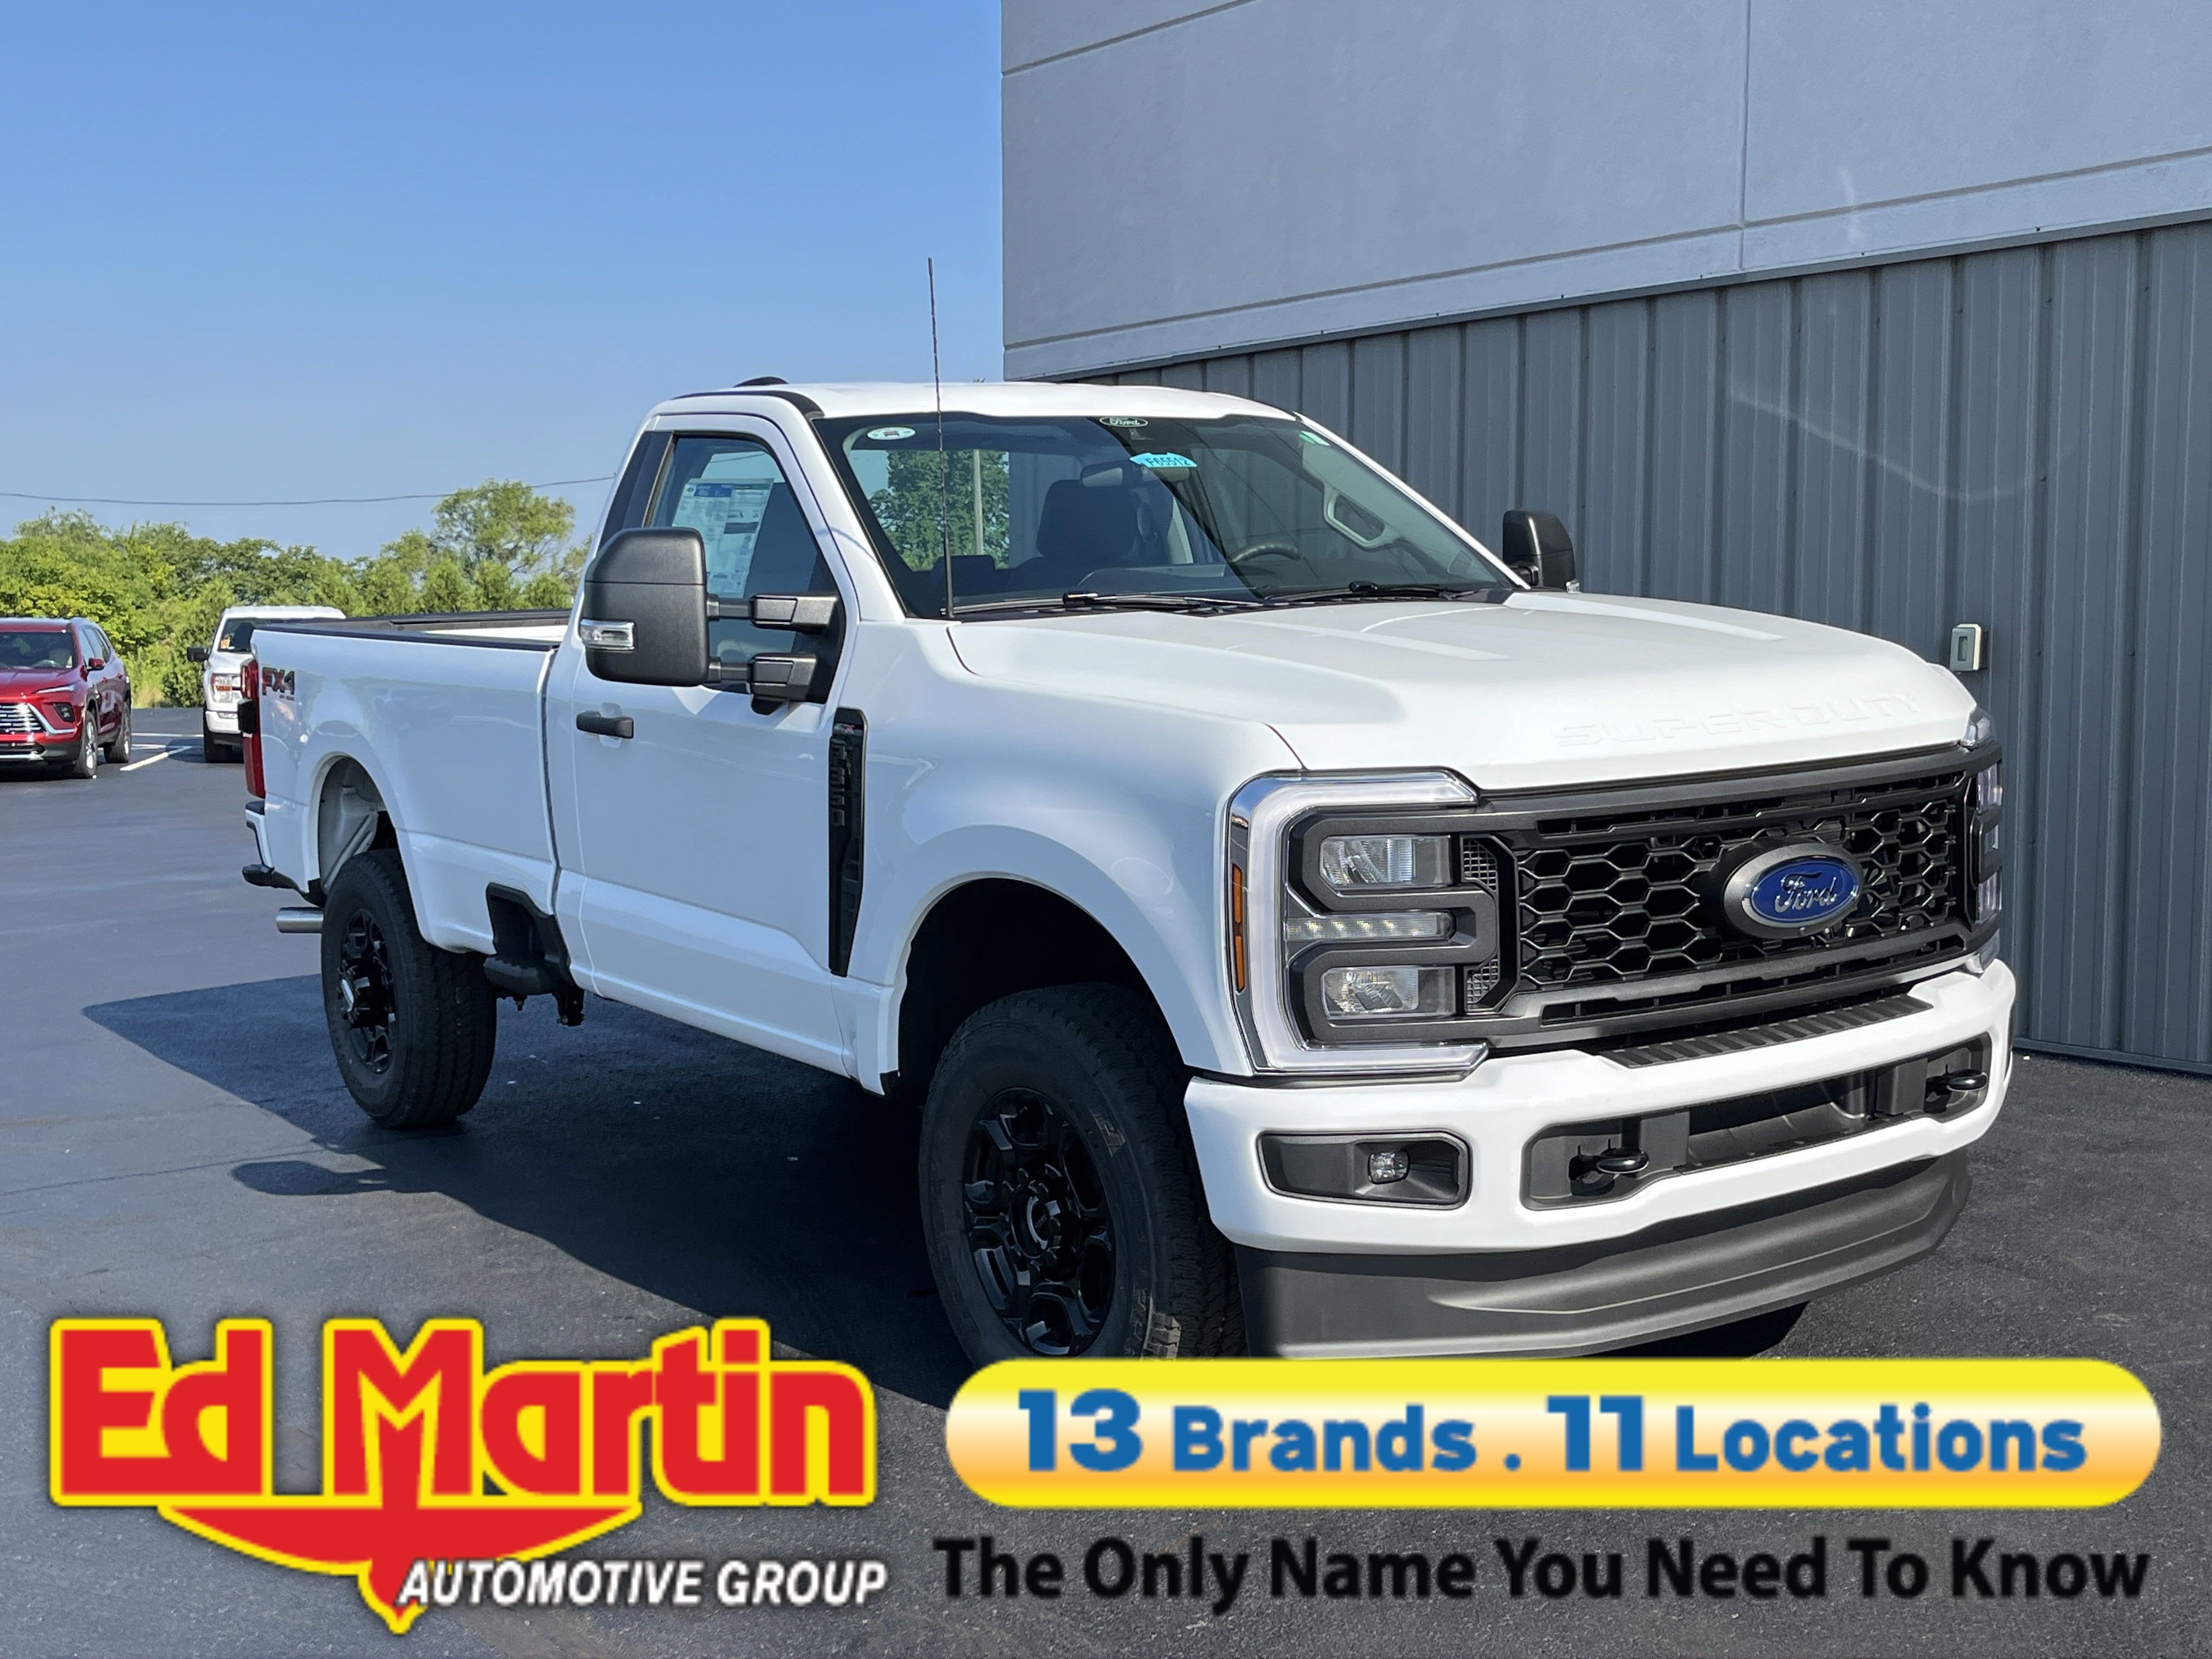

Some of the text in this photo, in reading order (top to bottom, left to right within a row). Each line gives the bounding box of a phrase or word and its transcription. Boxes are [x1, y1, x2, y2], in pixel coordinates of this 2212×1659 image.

[1109, 417, 1140, 425] Ford
[262, 667, 295, 696] FX4
[1555, 693, 1919, 747] SUPER DUTY
[1774, 871, 1838, 913] Ford
